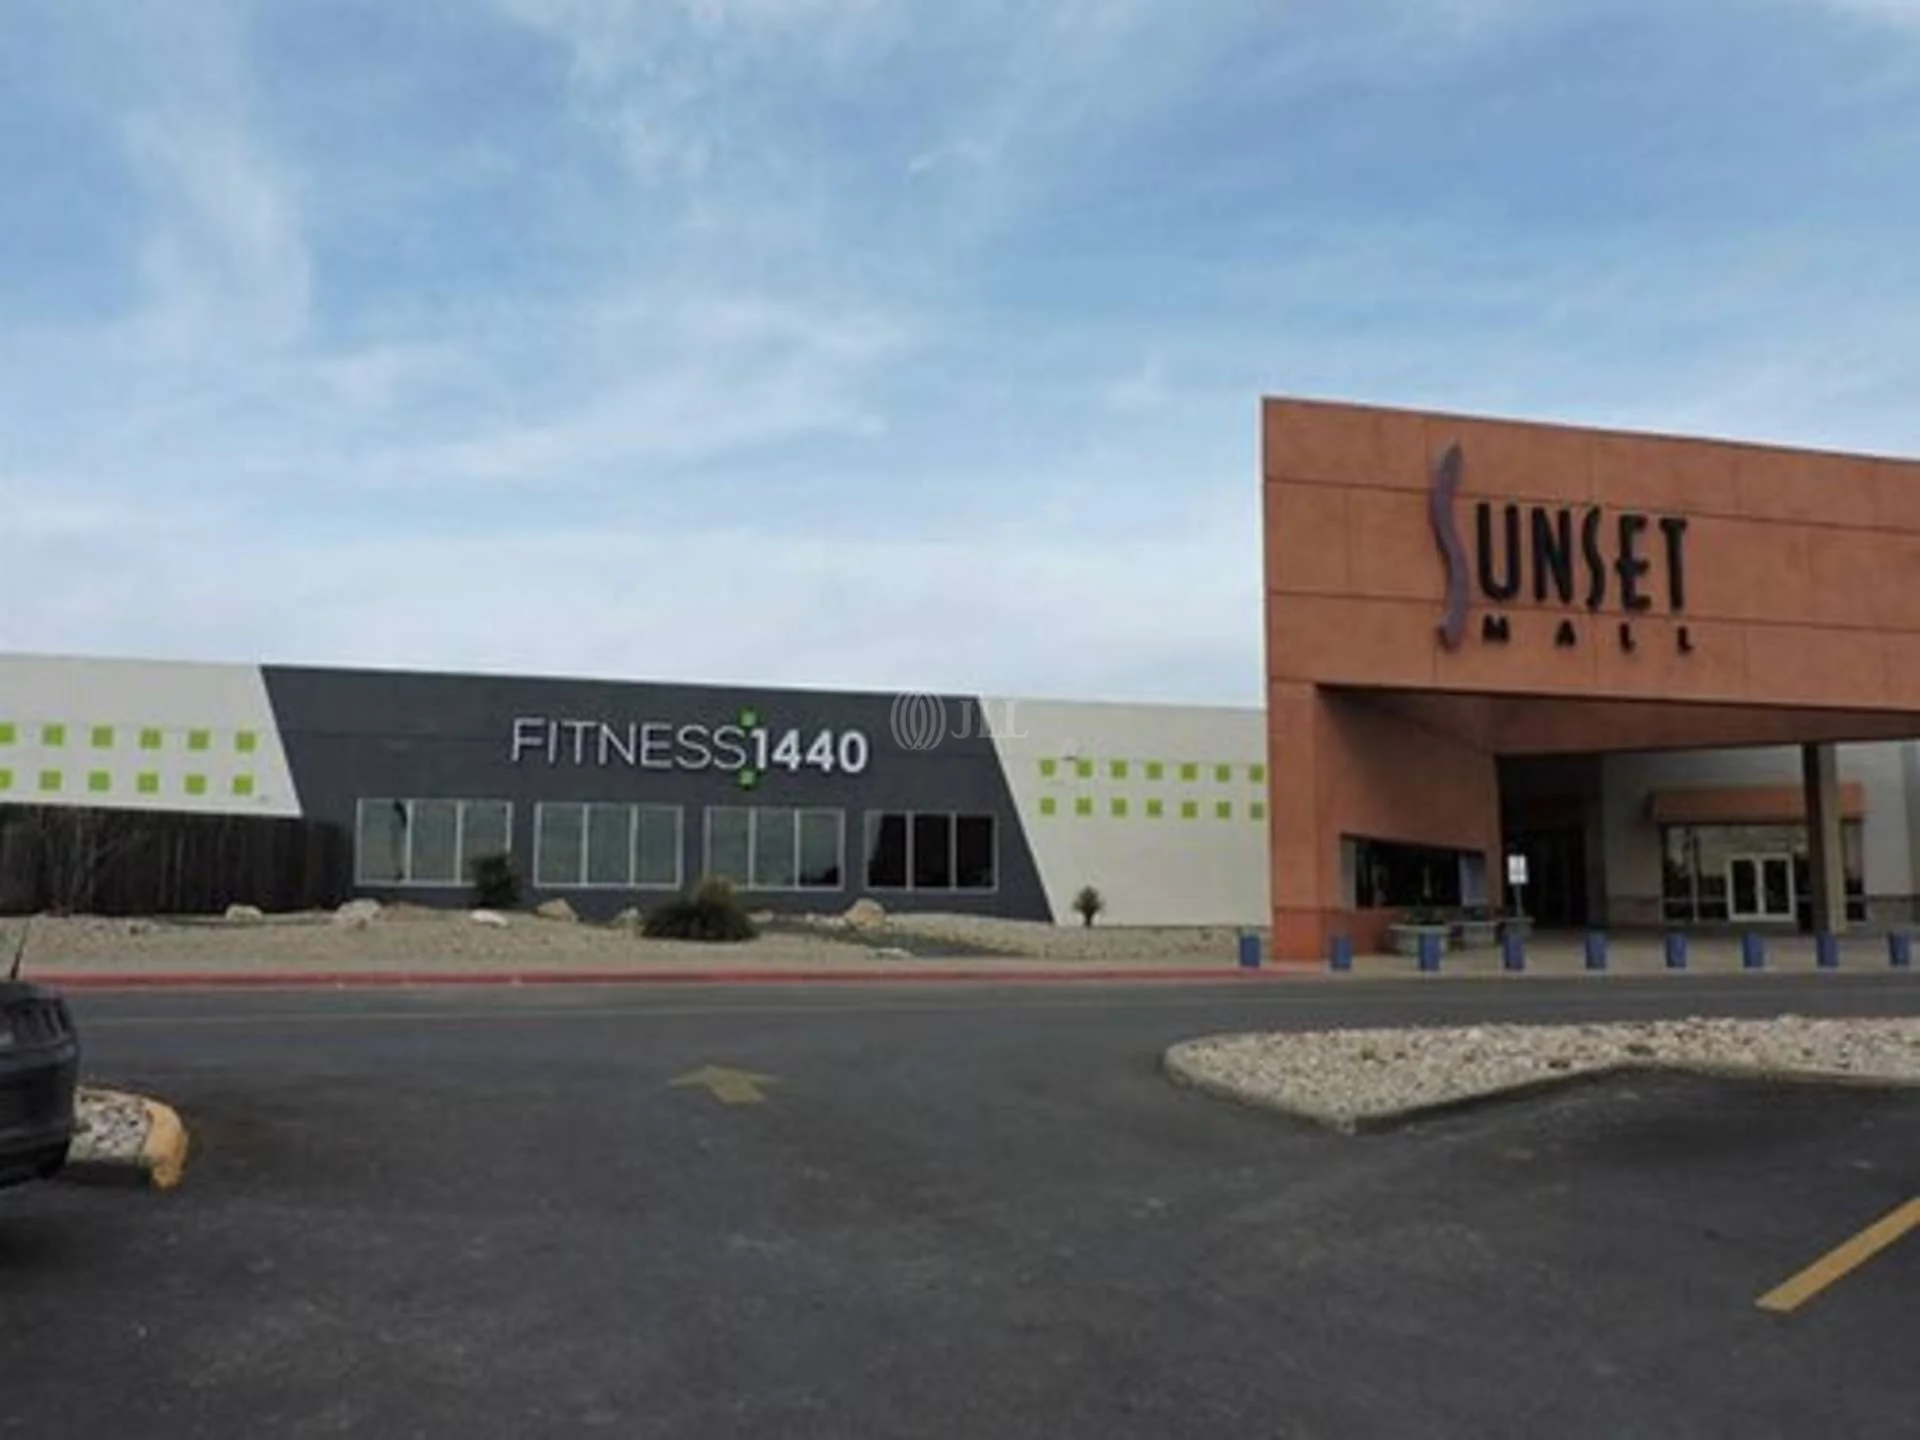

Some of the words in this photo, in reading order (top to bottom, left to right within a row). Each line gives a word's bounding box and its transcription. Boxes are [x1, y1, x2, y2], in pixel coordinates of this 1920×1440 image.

[1429, 442, 1688, 652] SUNSET
[1482, 613, 1694, 653] MALL
[510, 716, 747, 770] FITNESS
[750, 728, 868, 774] 1440
